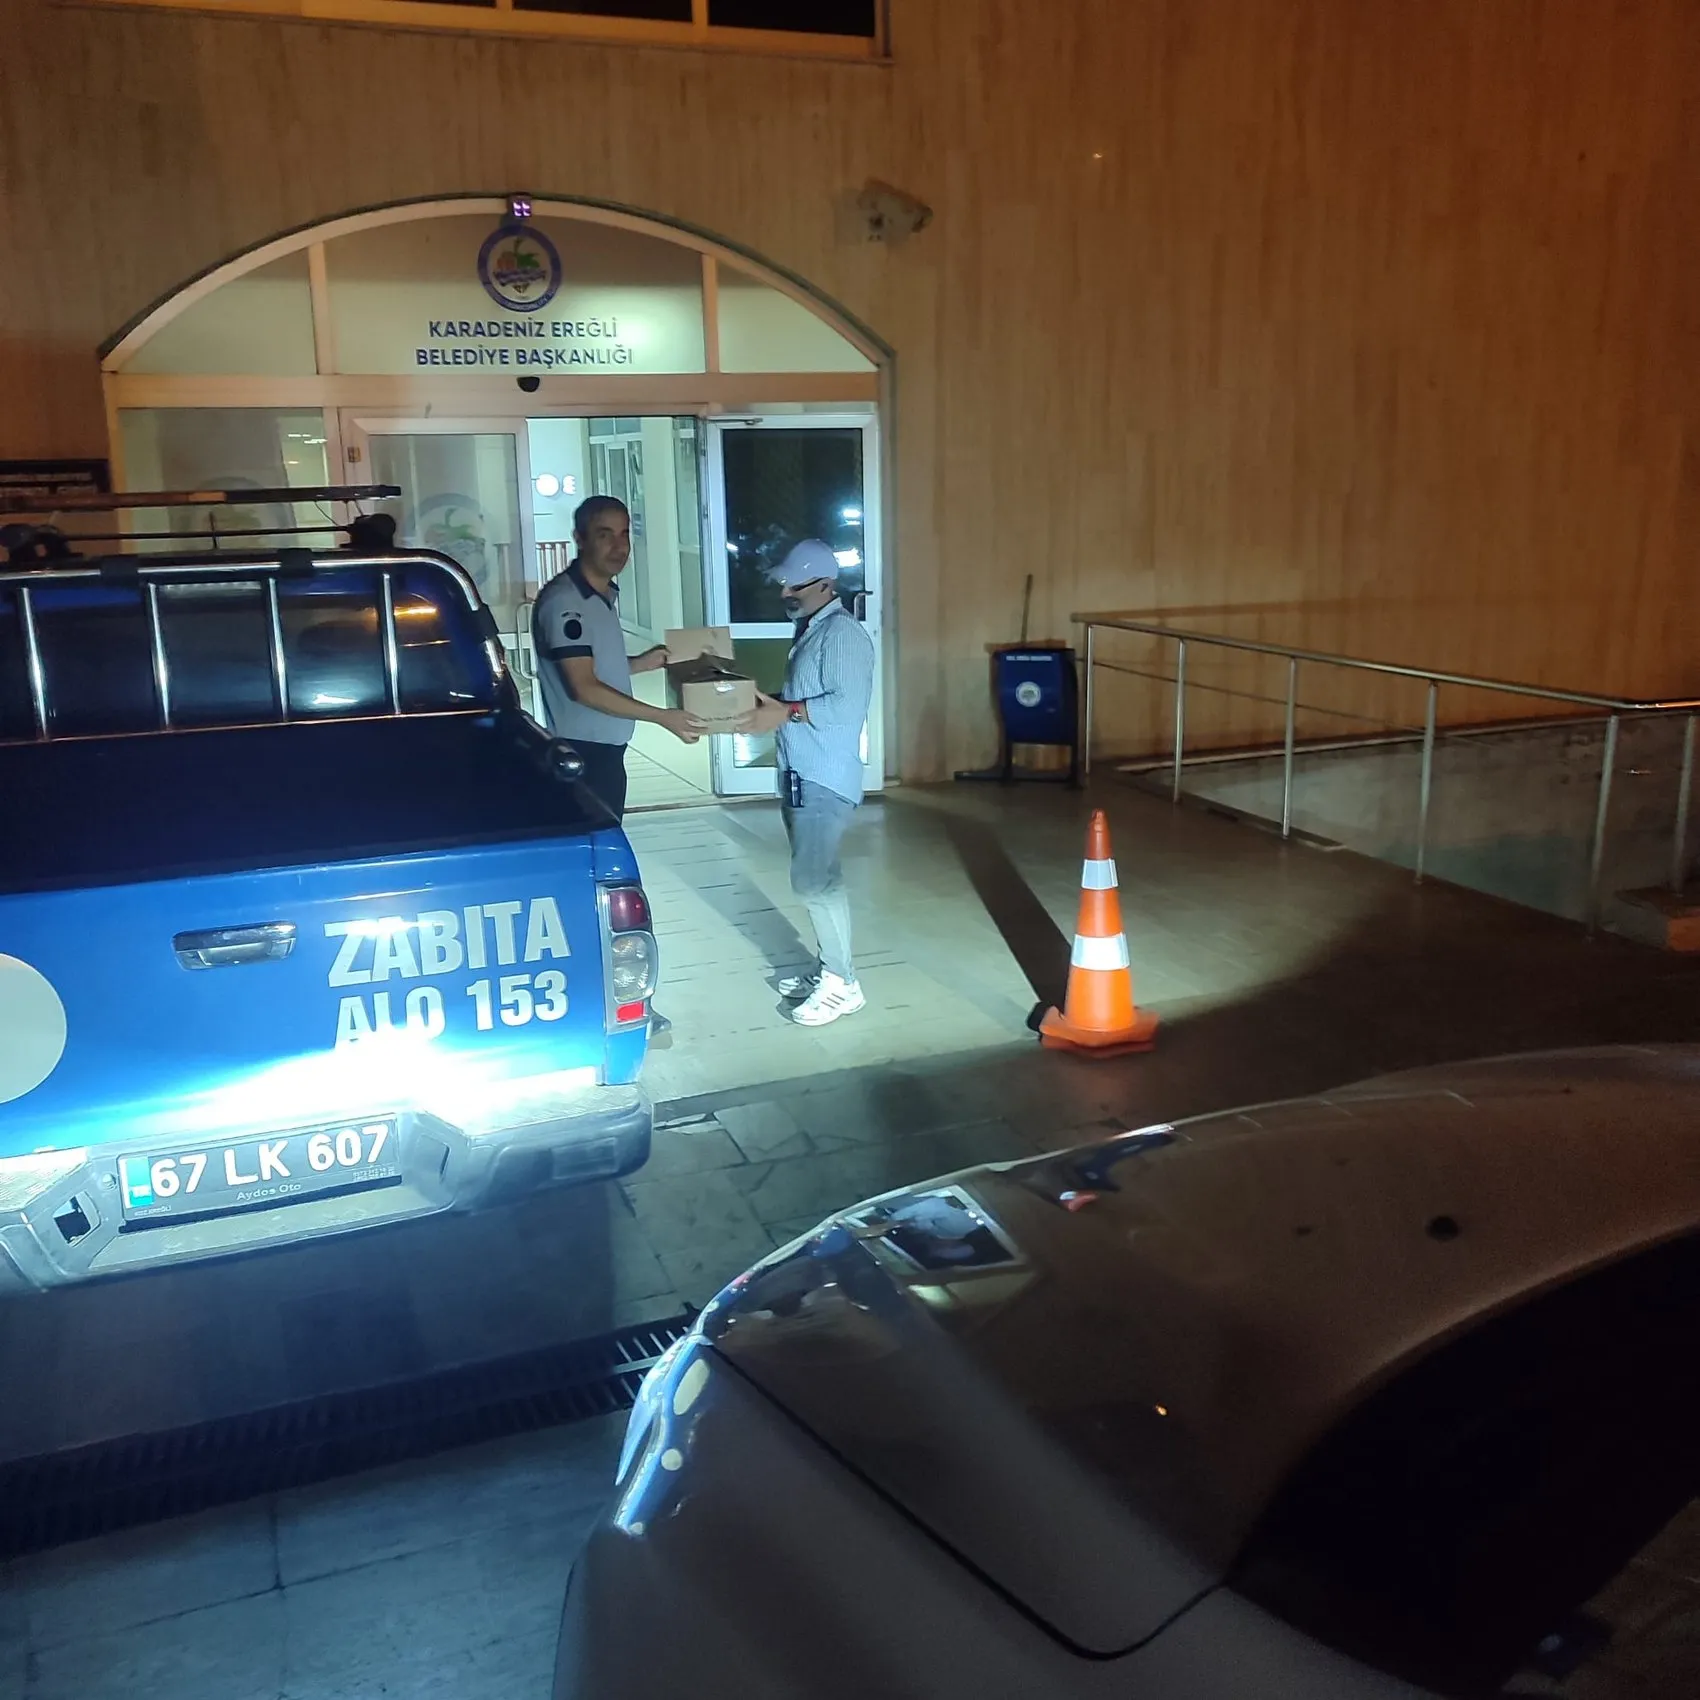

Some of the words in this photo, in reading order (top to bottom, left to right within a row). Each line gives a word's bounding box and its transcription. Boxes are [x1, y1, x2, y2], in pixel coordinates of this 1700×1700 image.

[429, 317, 546, 338] KARADENİZ
[551, 316, 617, 338] EREĞLİ
[415, 344, 510, 366] BELEDİYE
[515, 344, 633, 369] BAŞKANLIĞI
[323, 896, 571, 988] ZABITA
[335, 986, 446, 1051] ALO
[466, 970, 569, 1032] 153
[150, 1152, 208, 1198] 67
[223, 1140, 291, 1187] LK
[307, 1123, 389, 1172] 607
[236, 1188, 276, 1201] Aydos
[279, 1182, 302, 1194] Oto
